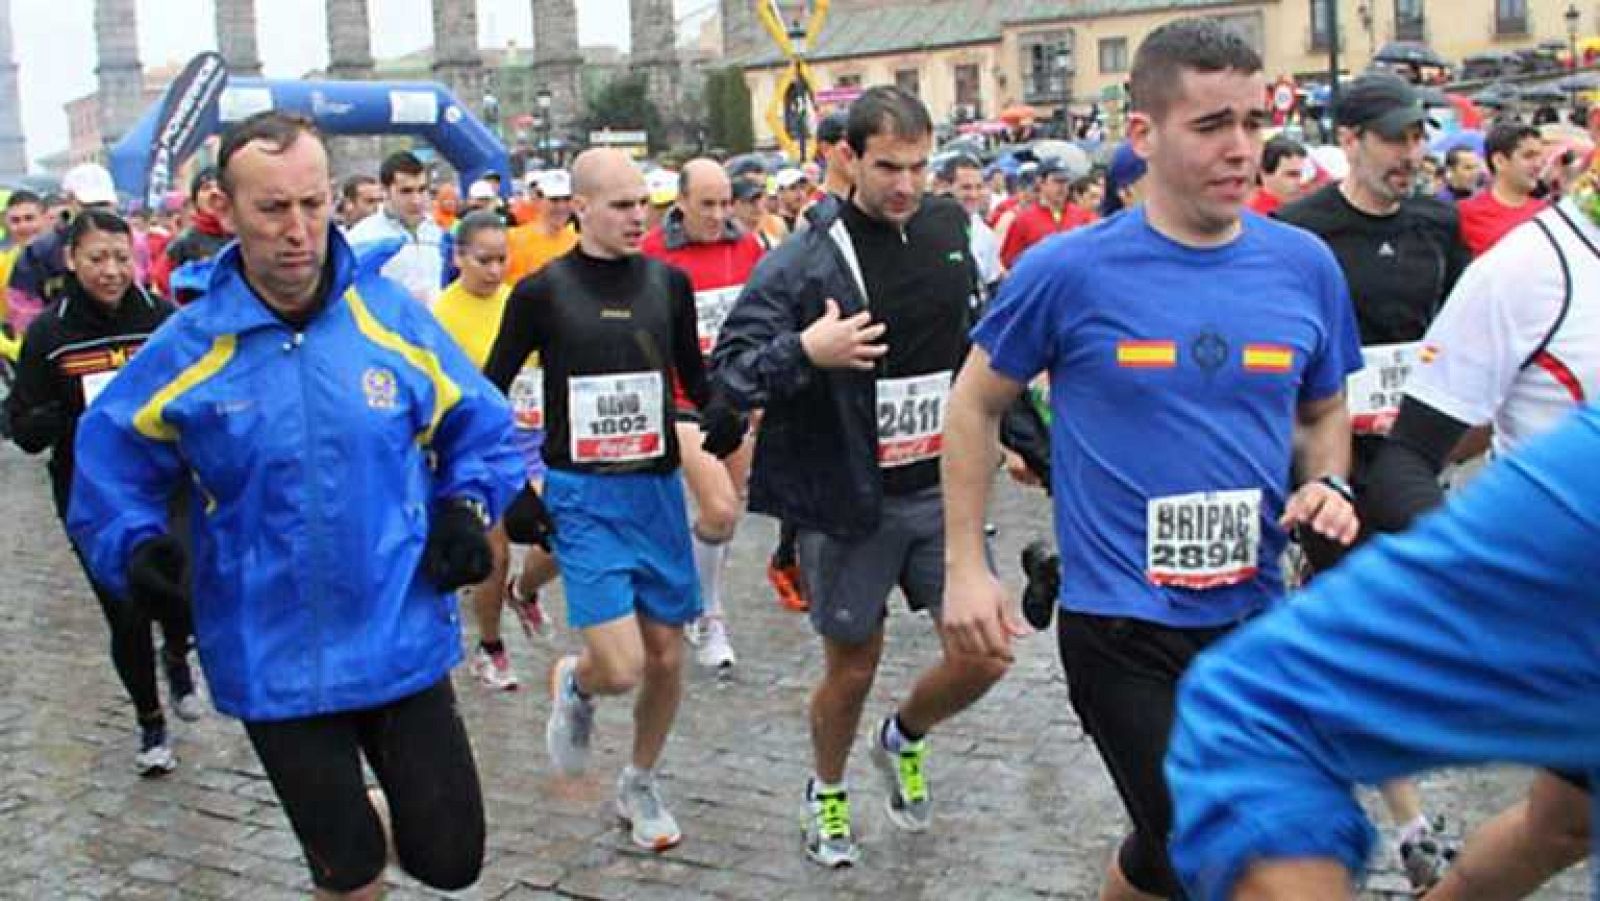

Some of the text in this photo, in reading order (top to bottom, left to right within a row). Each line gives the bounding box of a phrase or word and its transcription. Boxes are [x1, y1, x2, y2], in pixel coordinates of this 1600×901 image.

[590, 415, 647, 435] 1802
[879, 396, 941, 436] 2411
[1151, 538, 1250, 568] 2894
